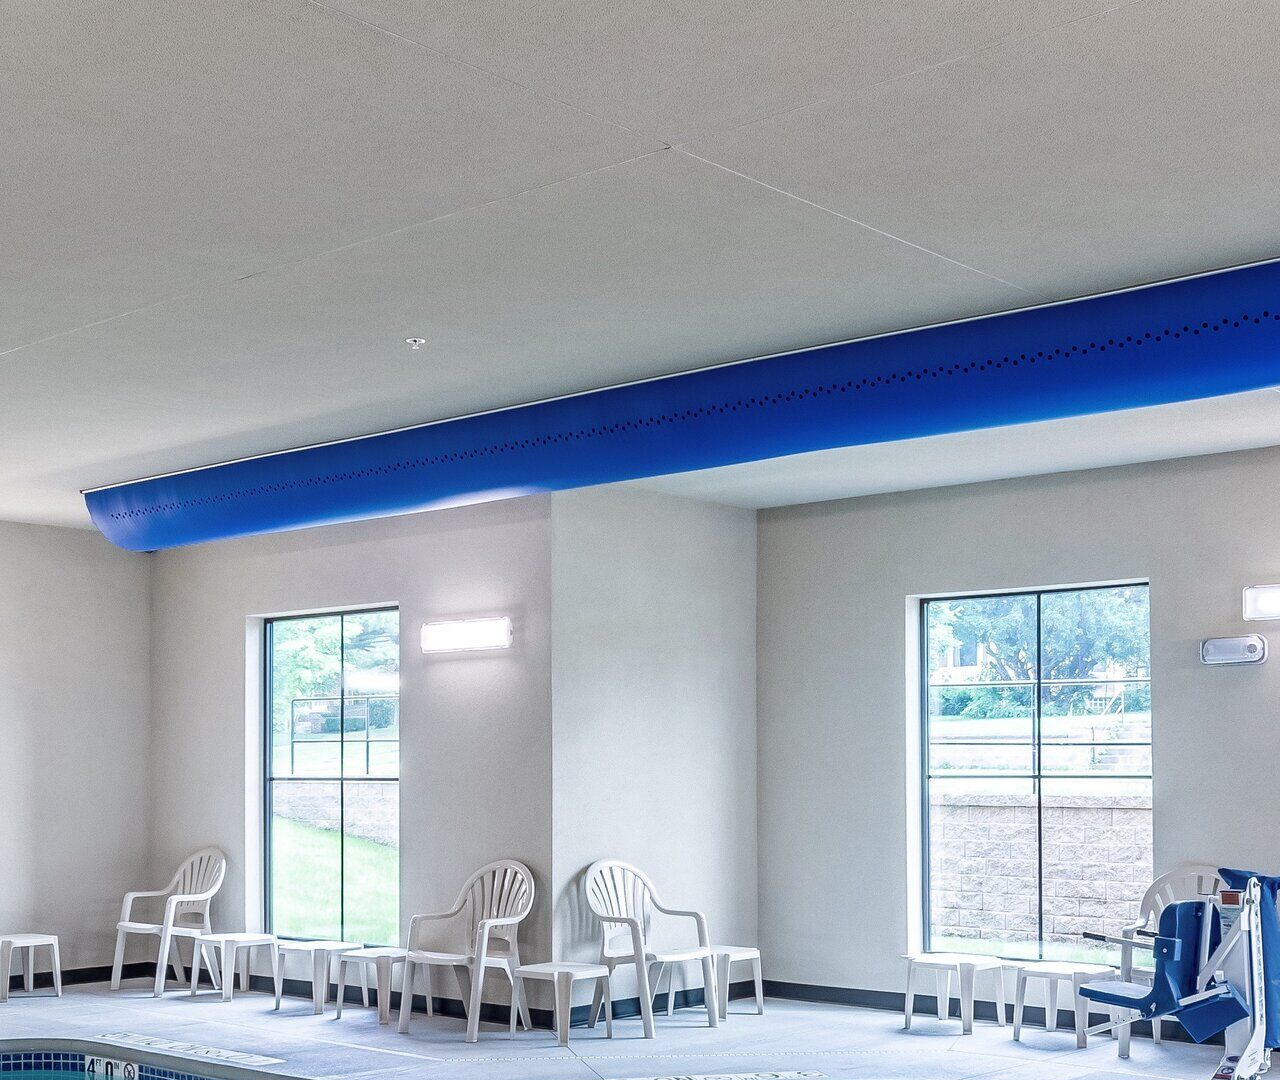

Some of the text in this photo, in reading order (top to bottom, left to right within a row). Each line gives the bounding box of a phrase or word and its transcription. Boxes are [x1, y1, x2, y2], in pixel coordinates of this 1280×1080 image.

[87, 1058, 96, 1073] 4
[95, 1059, 102, 1067] FT
[105, 1061, 113, 1076] 0
